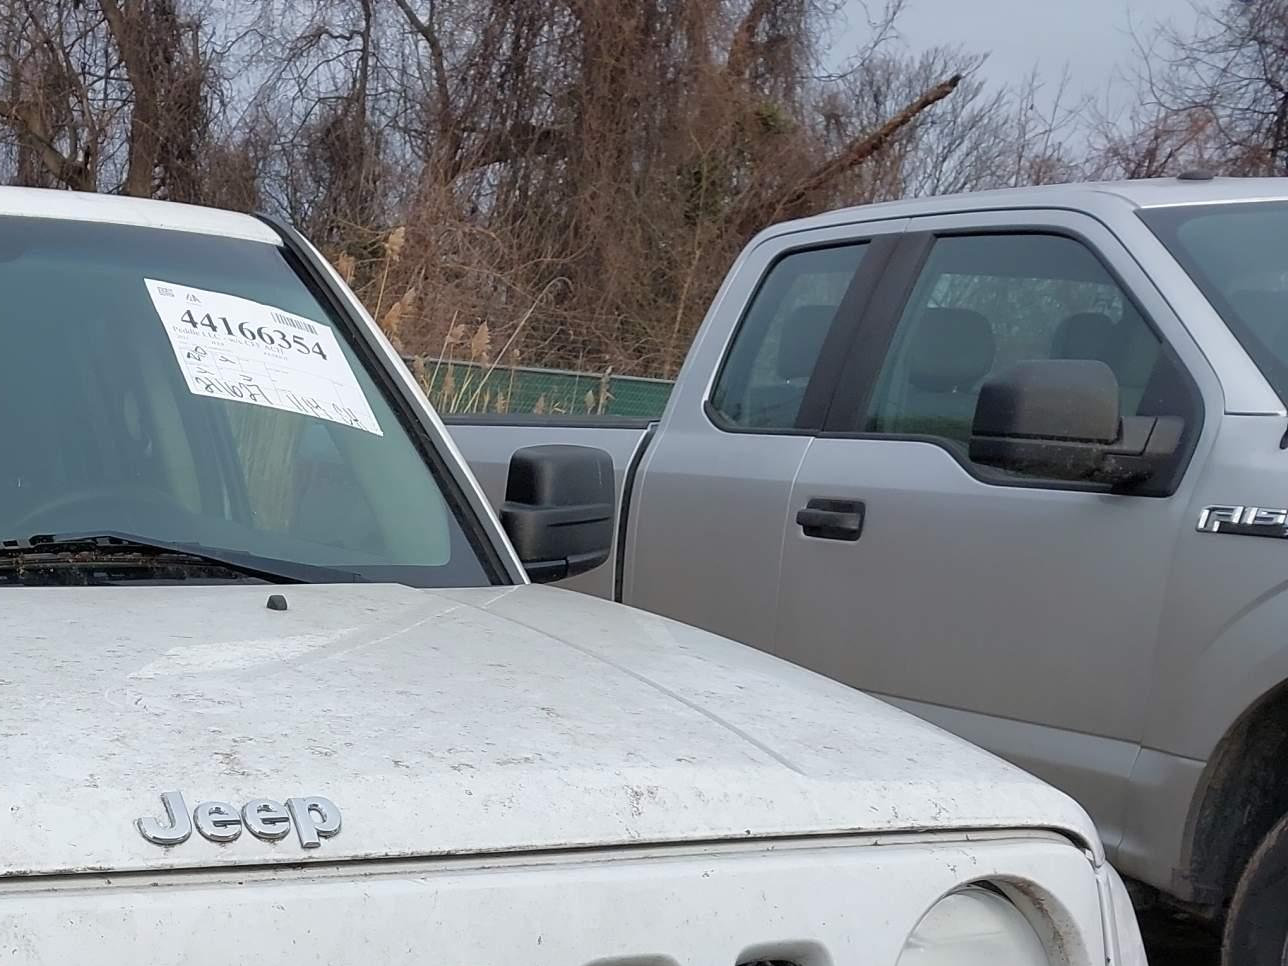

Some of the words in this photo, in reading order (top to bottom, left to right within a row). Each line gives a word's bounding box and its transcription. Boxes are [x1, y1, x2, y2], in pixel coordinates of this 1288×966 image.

[180, 309, 327, 361] 44166354
[1196, 504, 1288, 532] F15
[134, 791, 342, 849] Jeep
